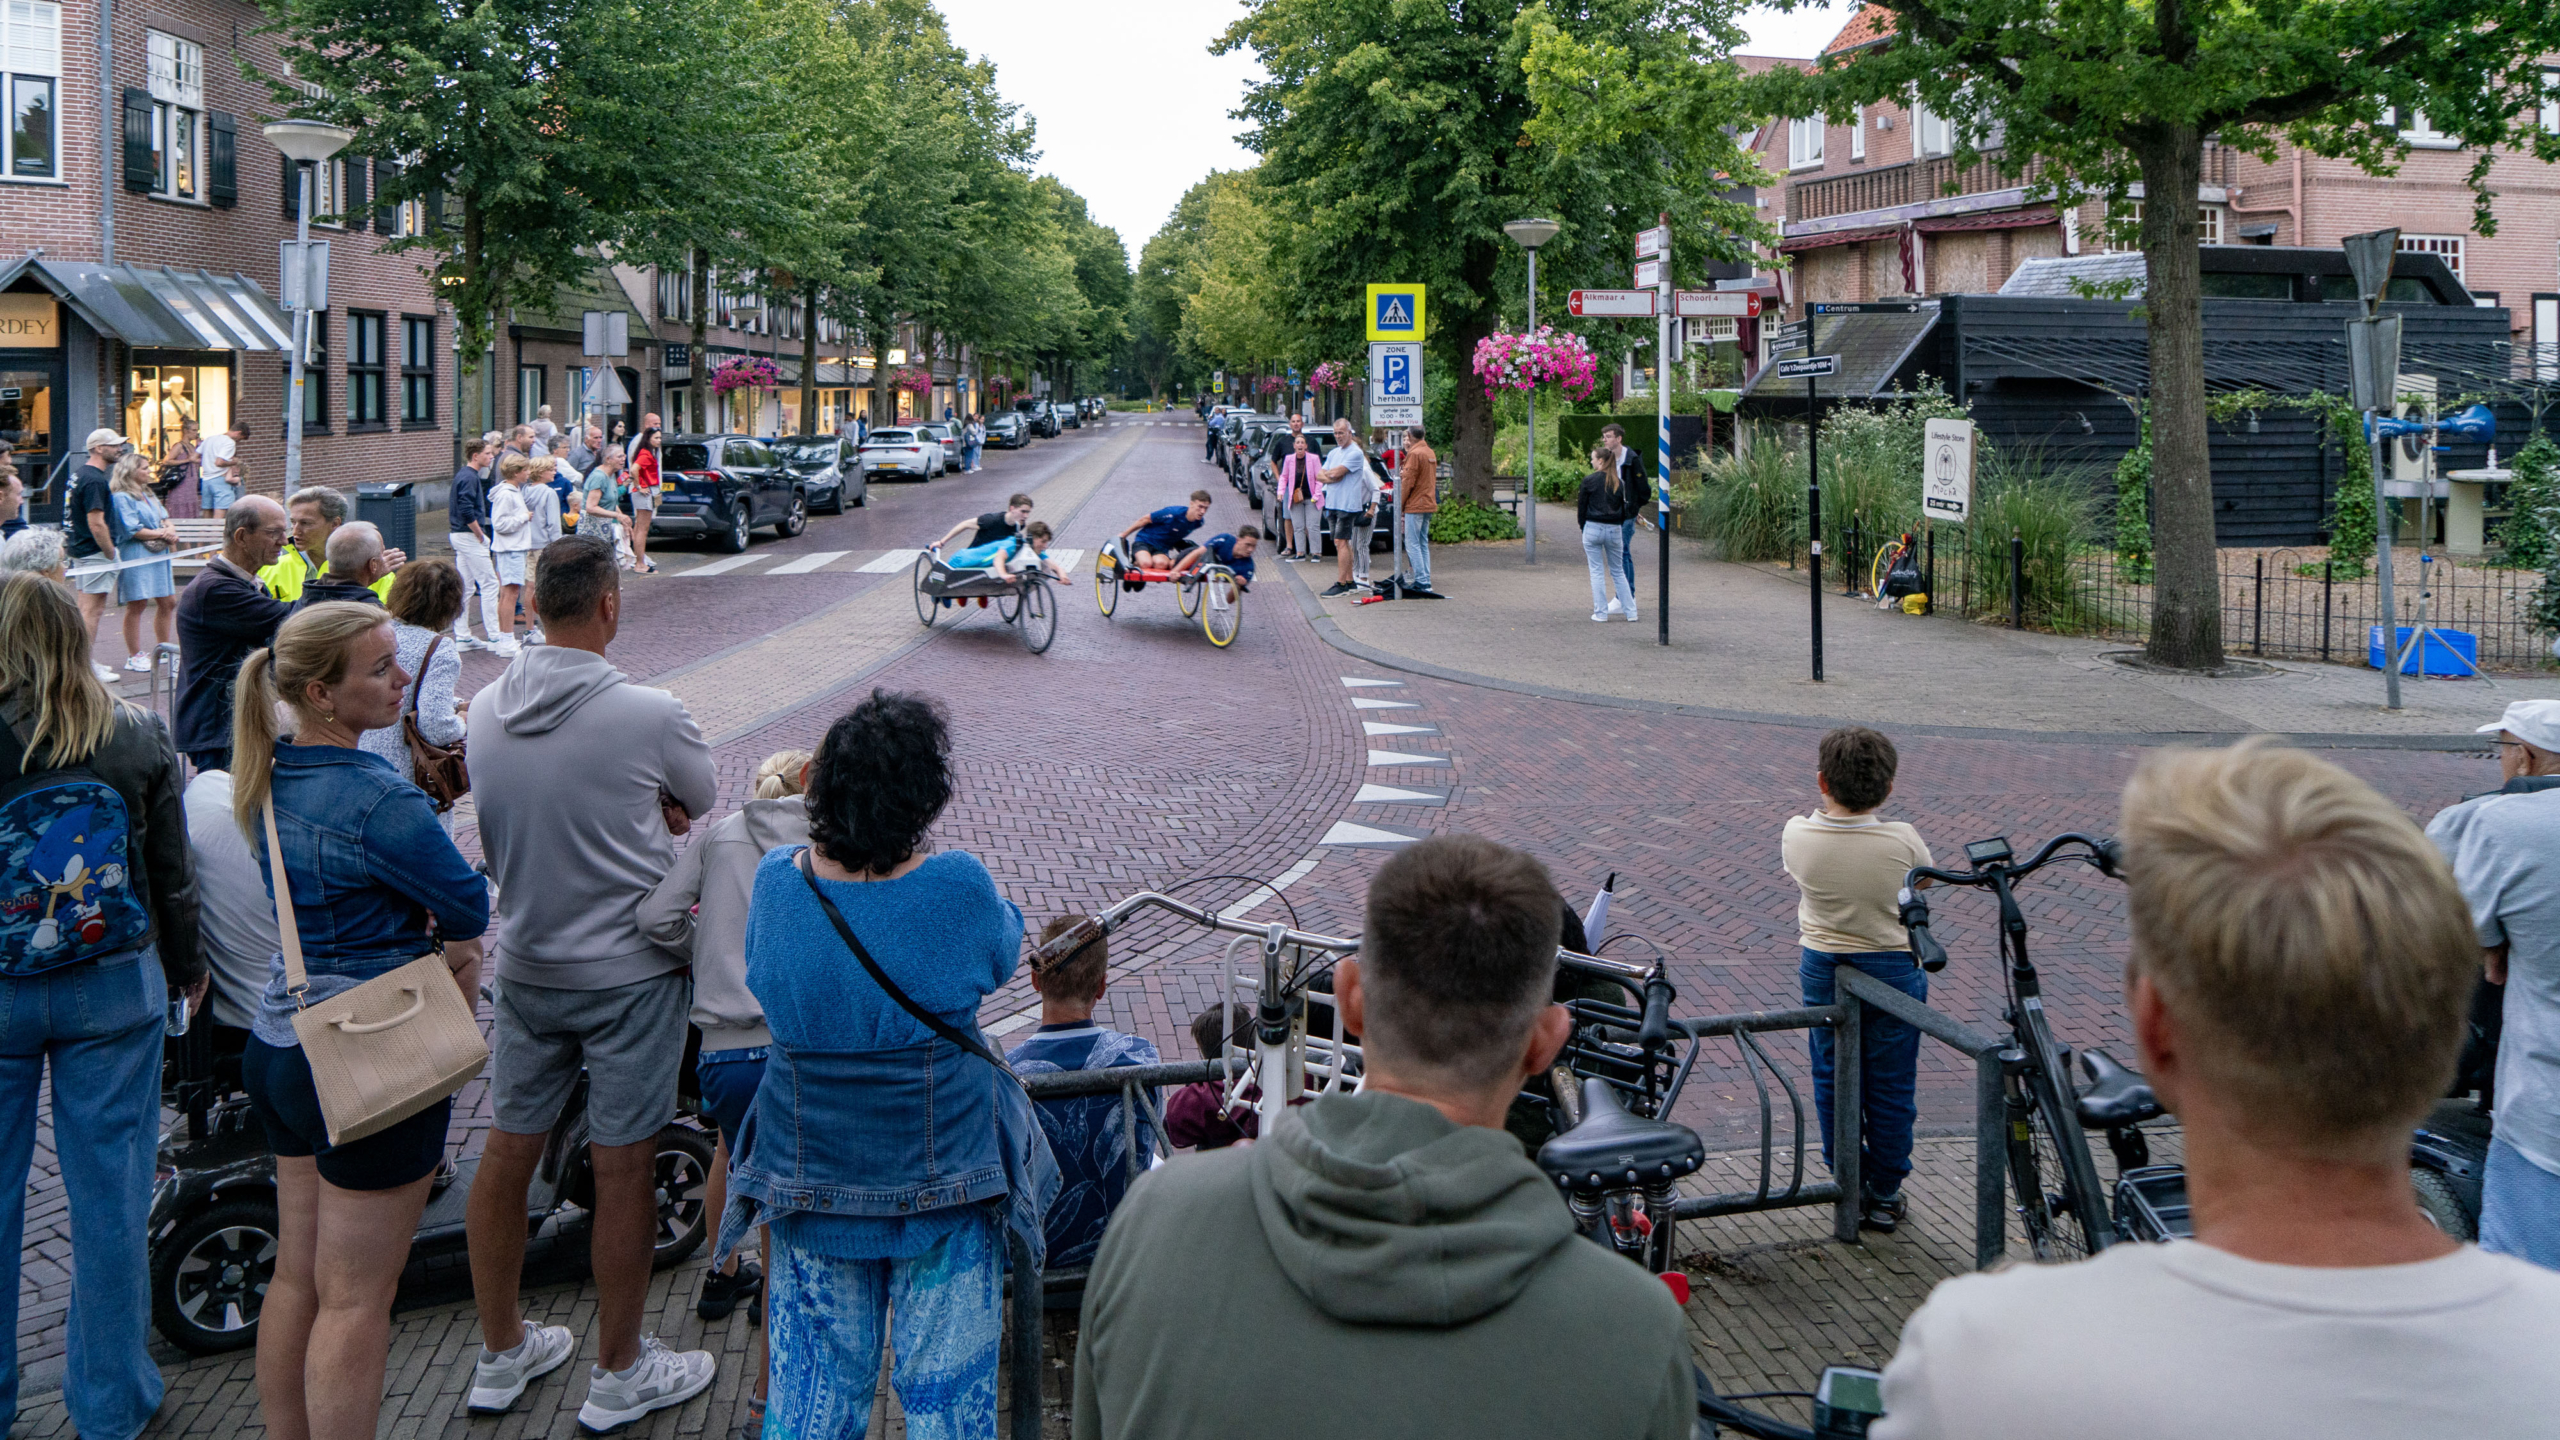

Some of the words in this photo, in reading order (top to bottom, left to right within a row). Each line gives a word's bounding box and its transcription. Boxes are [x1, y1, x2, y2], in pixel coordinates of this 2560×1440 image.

[1584, 293, 1618, 301] Alkmaar
[1388, 357, 1404, 379] P
[1931, 431, 1951, 442] Lifestyle
[1951, 434, 1966, 442] Store
[1932, 484, 1957, 496] Mocha
